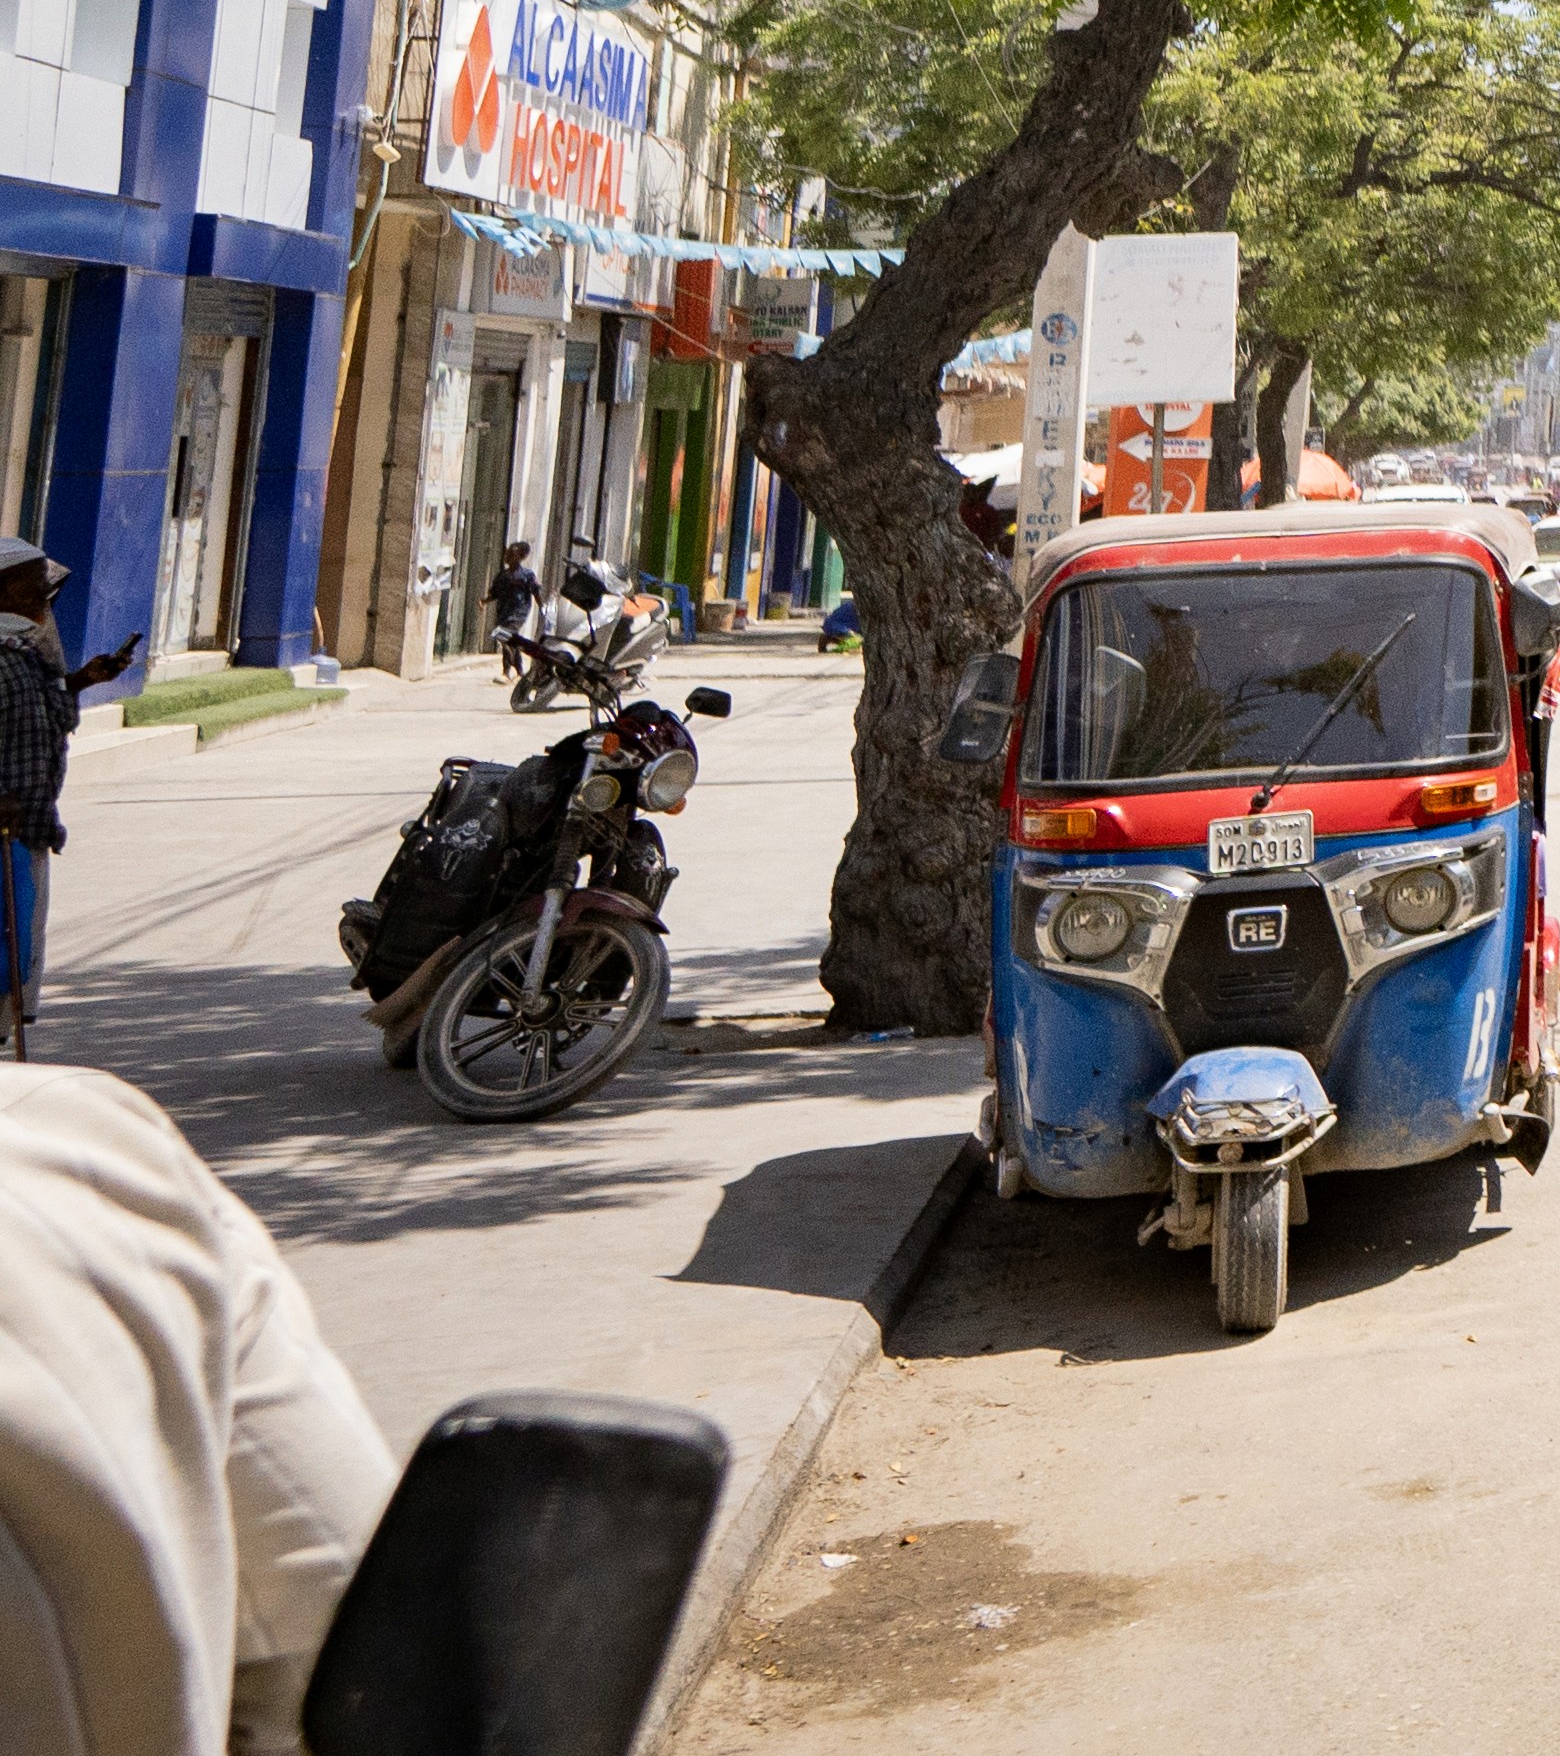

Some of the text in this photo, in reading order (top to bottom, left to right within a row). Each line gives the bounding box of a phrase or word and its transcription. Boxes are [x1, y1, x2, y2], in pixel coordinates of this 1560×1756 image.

[510, 102, 627, 217] HOSPITAL
[1216, 825, 1243, 838] SOM
[1228, 920, 1277, 943] RE
[1463, 986, 1497, 1080] B
